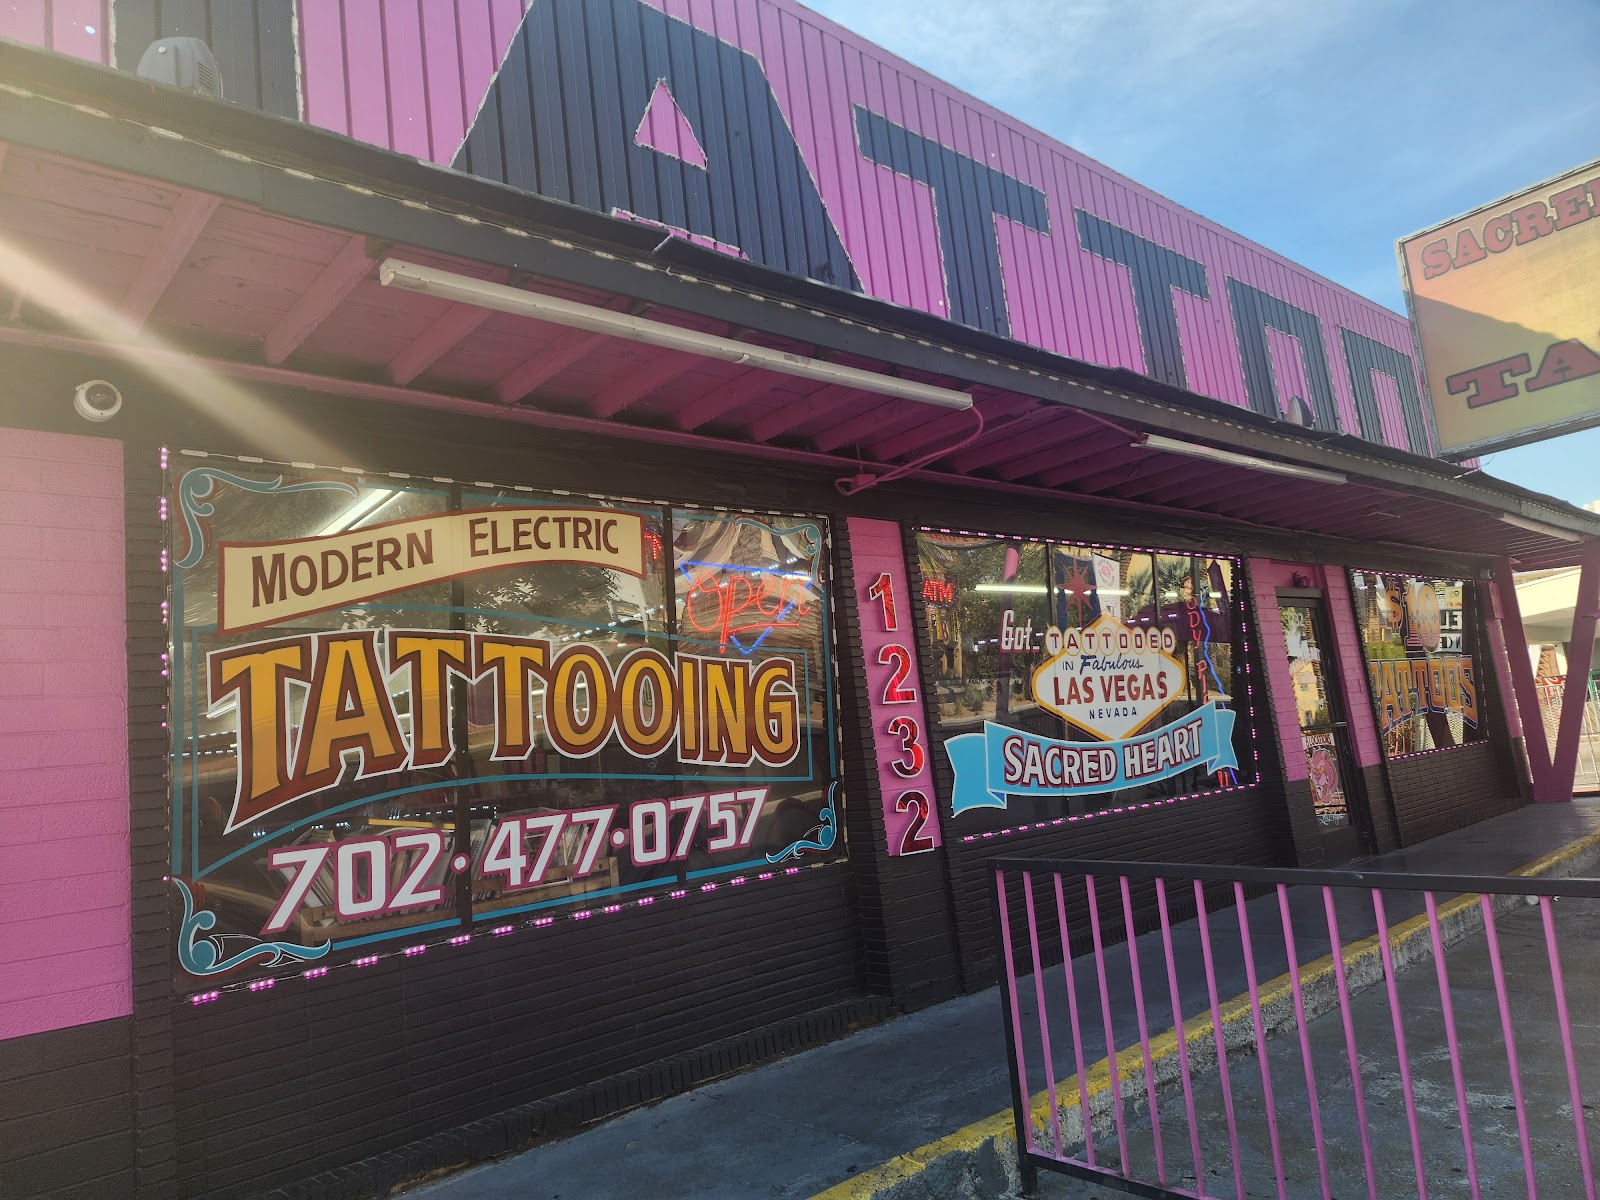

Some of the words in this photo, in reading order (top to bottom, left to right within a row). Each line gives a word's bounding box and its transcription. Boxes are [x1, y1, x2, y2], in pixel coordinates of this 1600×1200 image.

[251, 528, 435, 608] MODERN
[468, 516, 620, 558] ELECTRIC
[923, 580, 954, 603] ATM
[688, 573, 811, 654] Open
[1048, 630, 1174, 652] TATTOOED
[1062, 661, 1074, 671] IN
[1080, 653, 1144, 676] Fabulous
[1053, 675, 1095, 706] LAS
[1100, 671, 1168, 703] VEGAS
[1089, 707, 1138, 720] NEVADA
[206, 628, 801, 835] TATTOOING
[1004, 734, 1119, 789] SACRED
[1123, 717, 1203, 780] HEART
